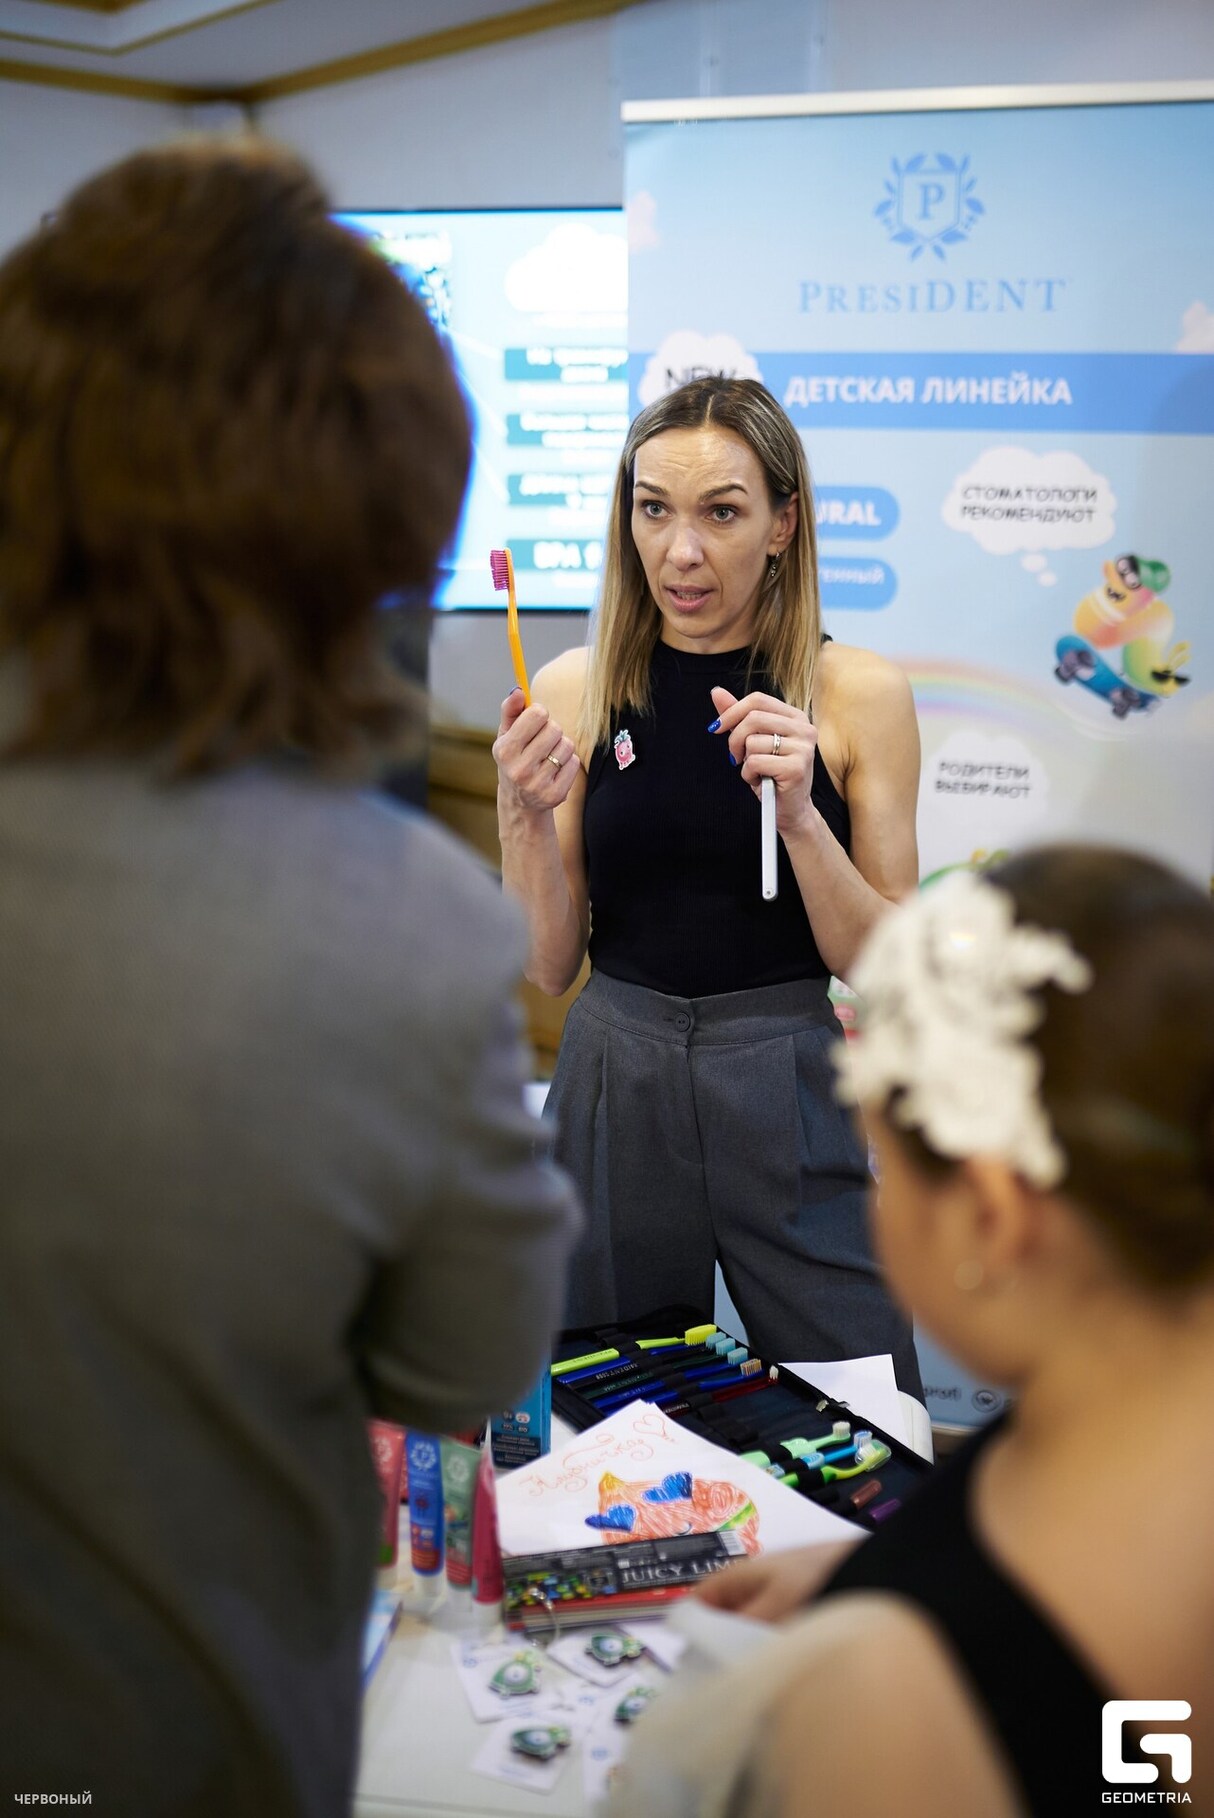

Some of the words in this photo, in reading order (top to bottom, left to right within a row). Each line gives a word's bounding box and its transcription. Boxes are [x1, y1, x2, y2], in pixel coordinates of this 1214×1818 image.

[918, 182, 946, 221] P
[784, 376, 916, 407] ДЕТСКАЯ
[922, 370, 1074, 405] ЛИНЕЙКА
[962, 485, 1098, 503] СТОМАТОЛОГИ
[961, 505, 1097, 524] РЕКОМЕНДУЮТ
[939, 760, 1030, 780] РОДИТЕЛИ
[935, 780, 1033, 800] ВЫБИРАЮТ
[622, 1564, 685, 1584] JUICY
[690, 1557, 738, 1575] LIM
